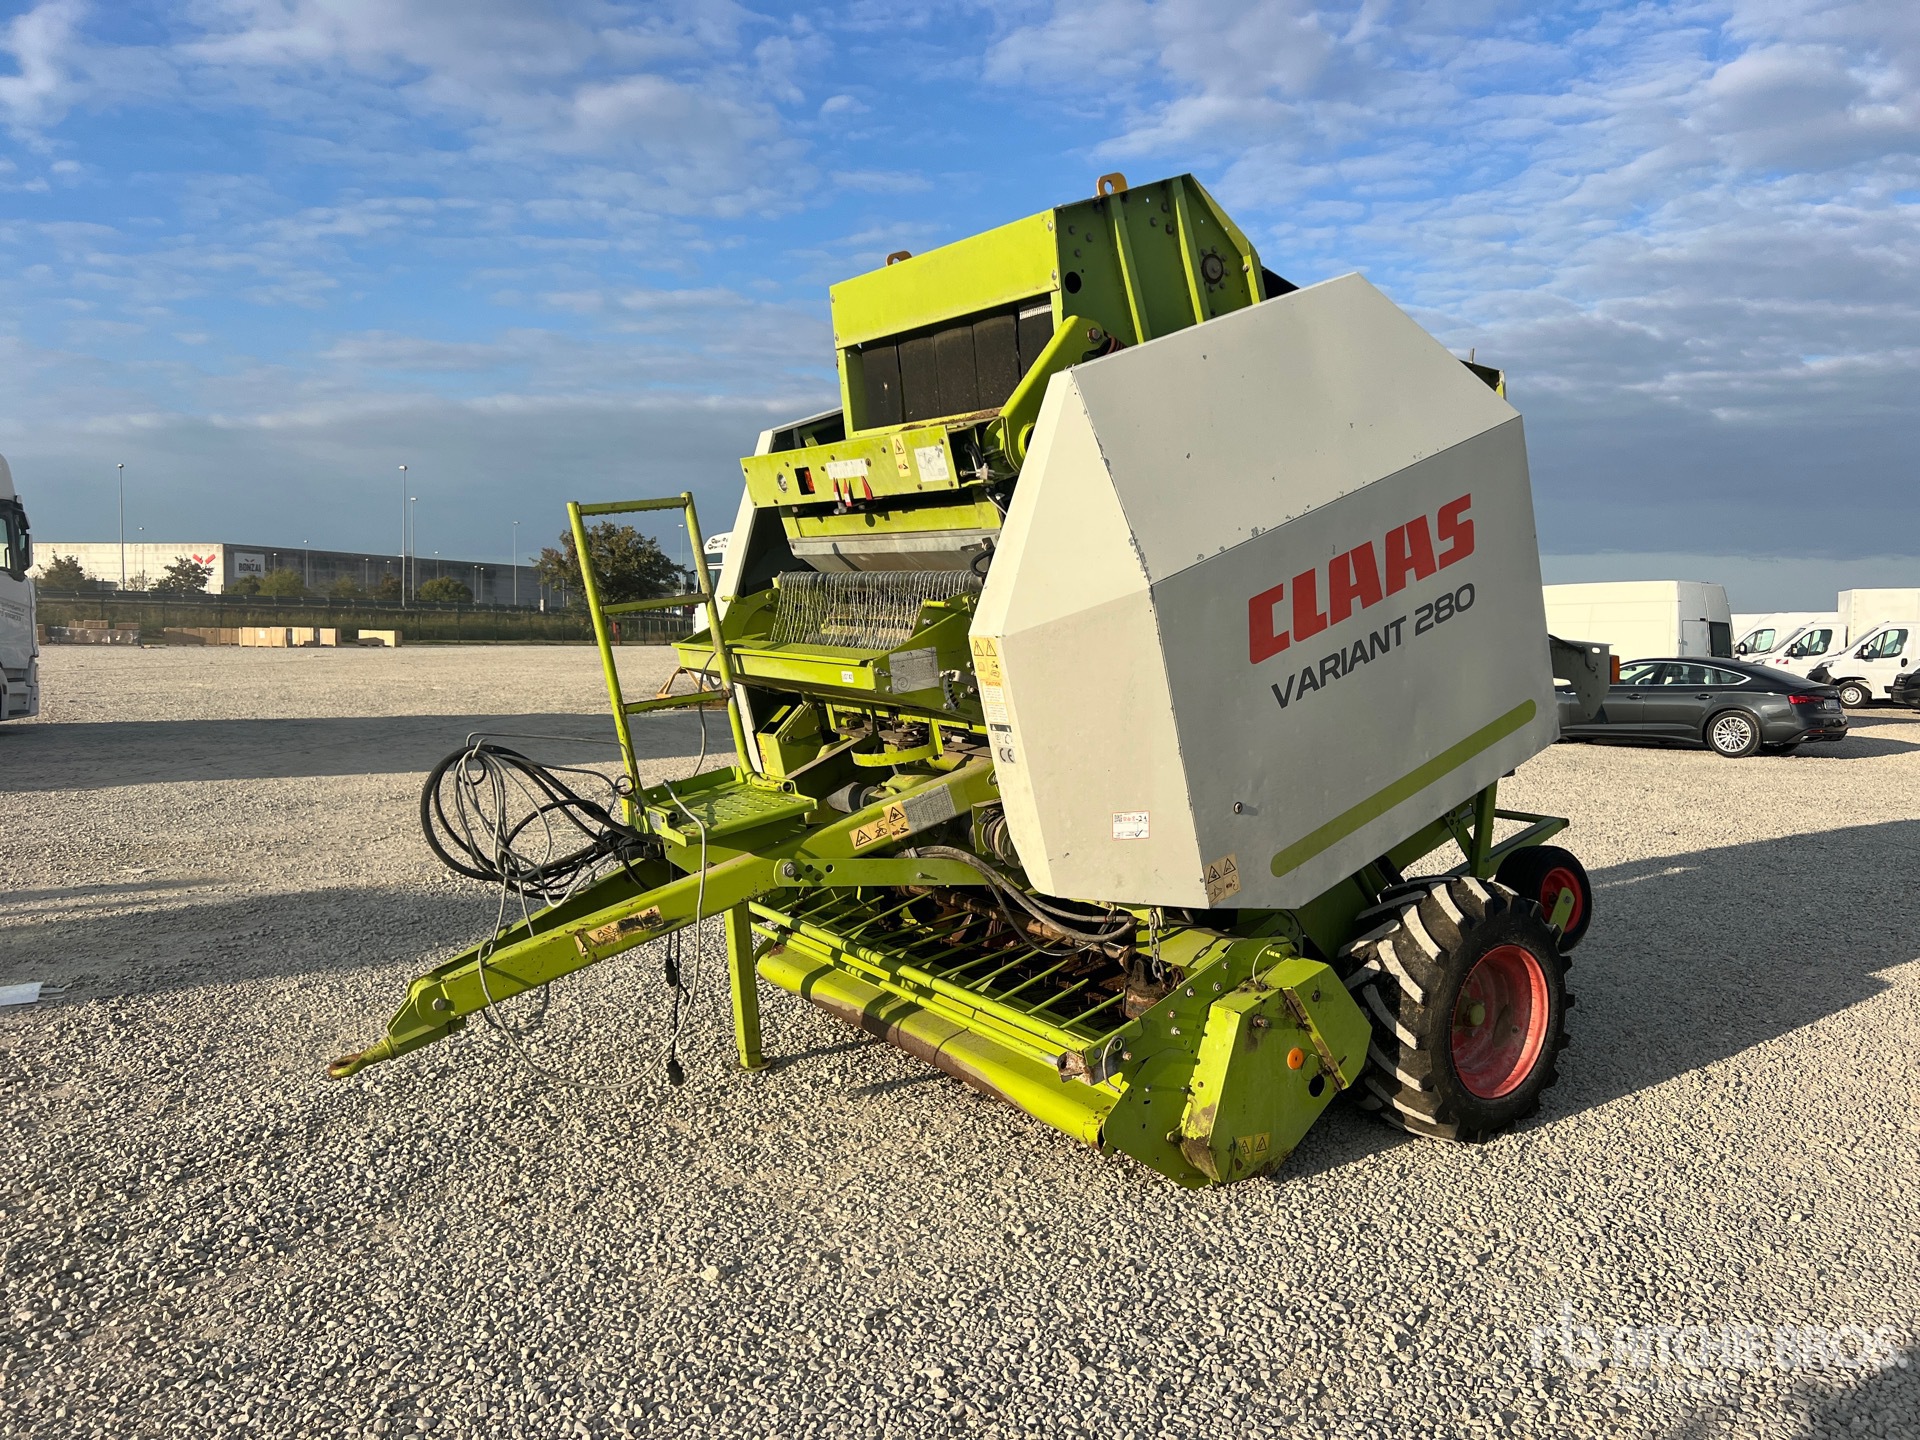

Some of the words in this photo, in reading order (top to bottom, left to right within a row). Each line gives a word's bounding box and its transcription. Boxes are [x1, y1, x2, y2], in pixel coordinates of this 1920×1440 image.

[238, 563, 262, 573] BONZAI
[1249, 493, 1475, 664] CLAAS
[1270, 615, 1407, 709] VARIANT
[1414, 582, 1476, 636] 280
